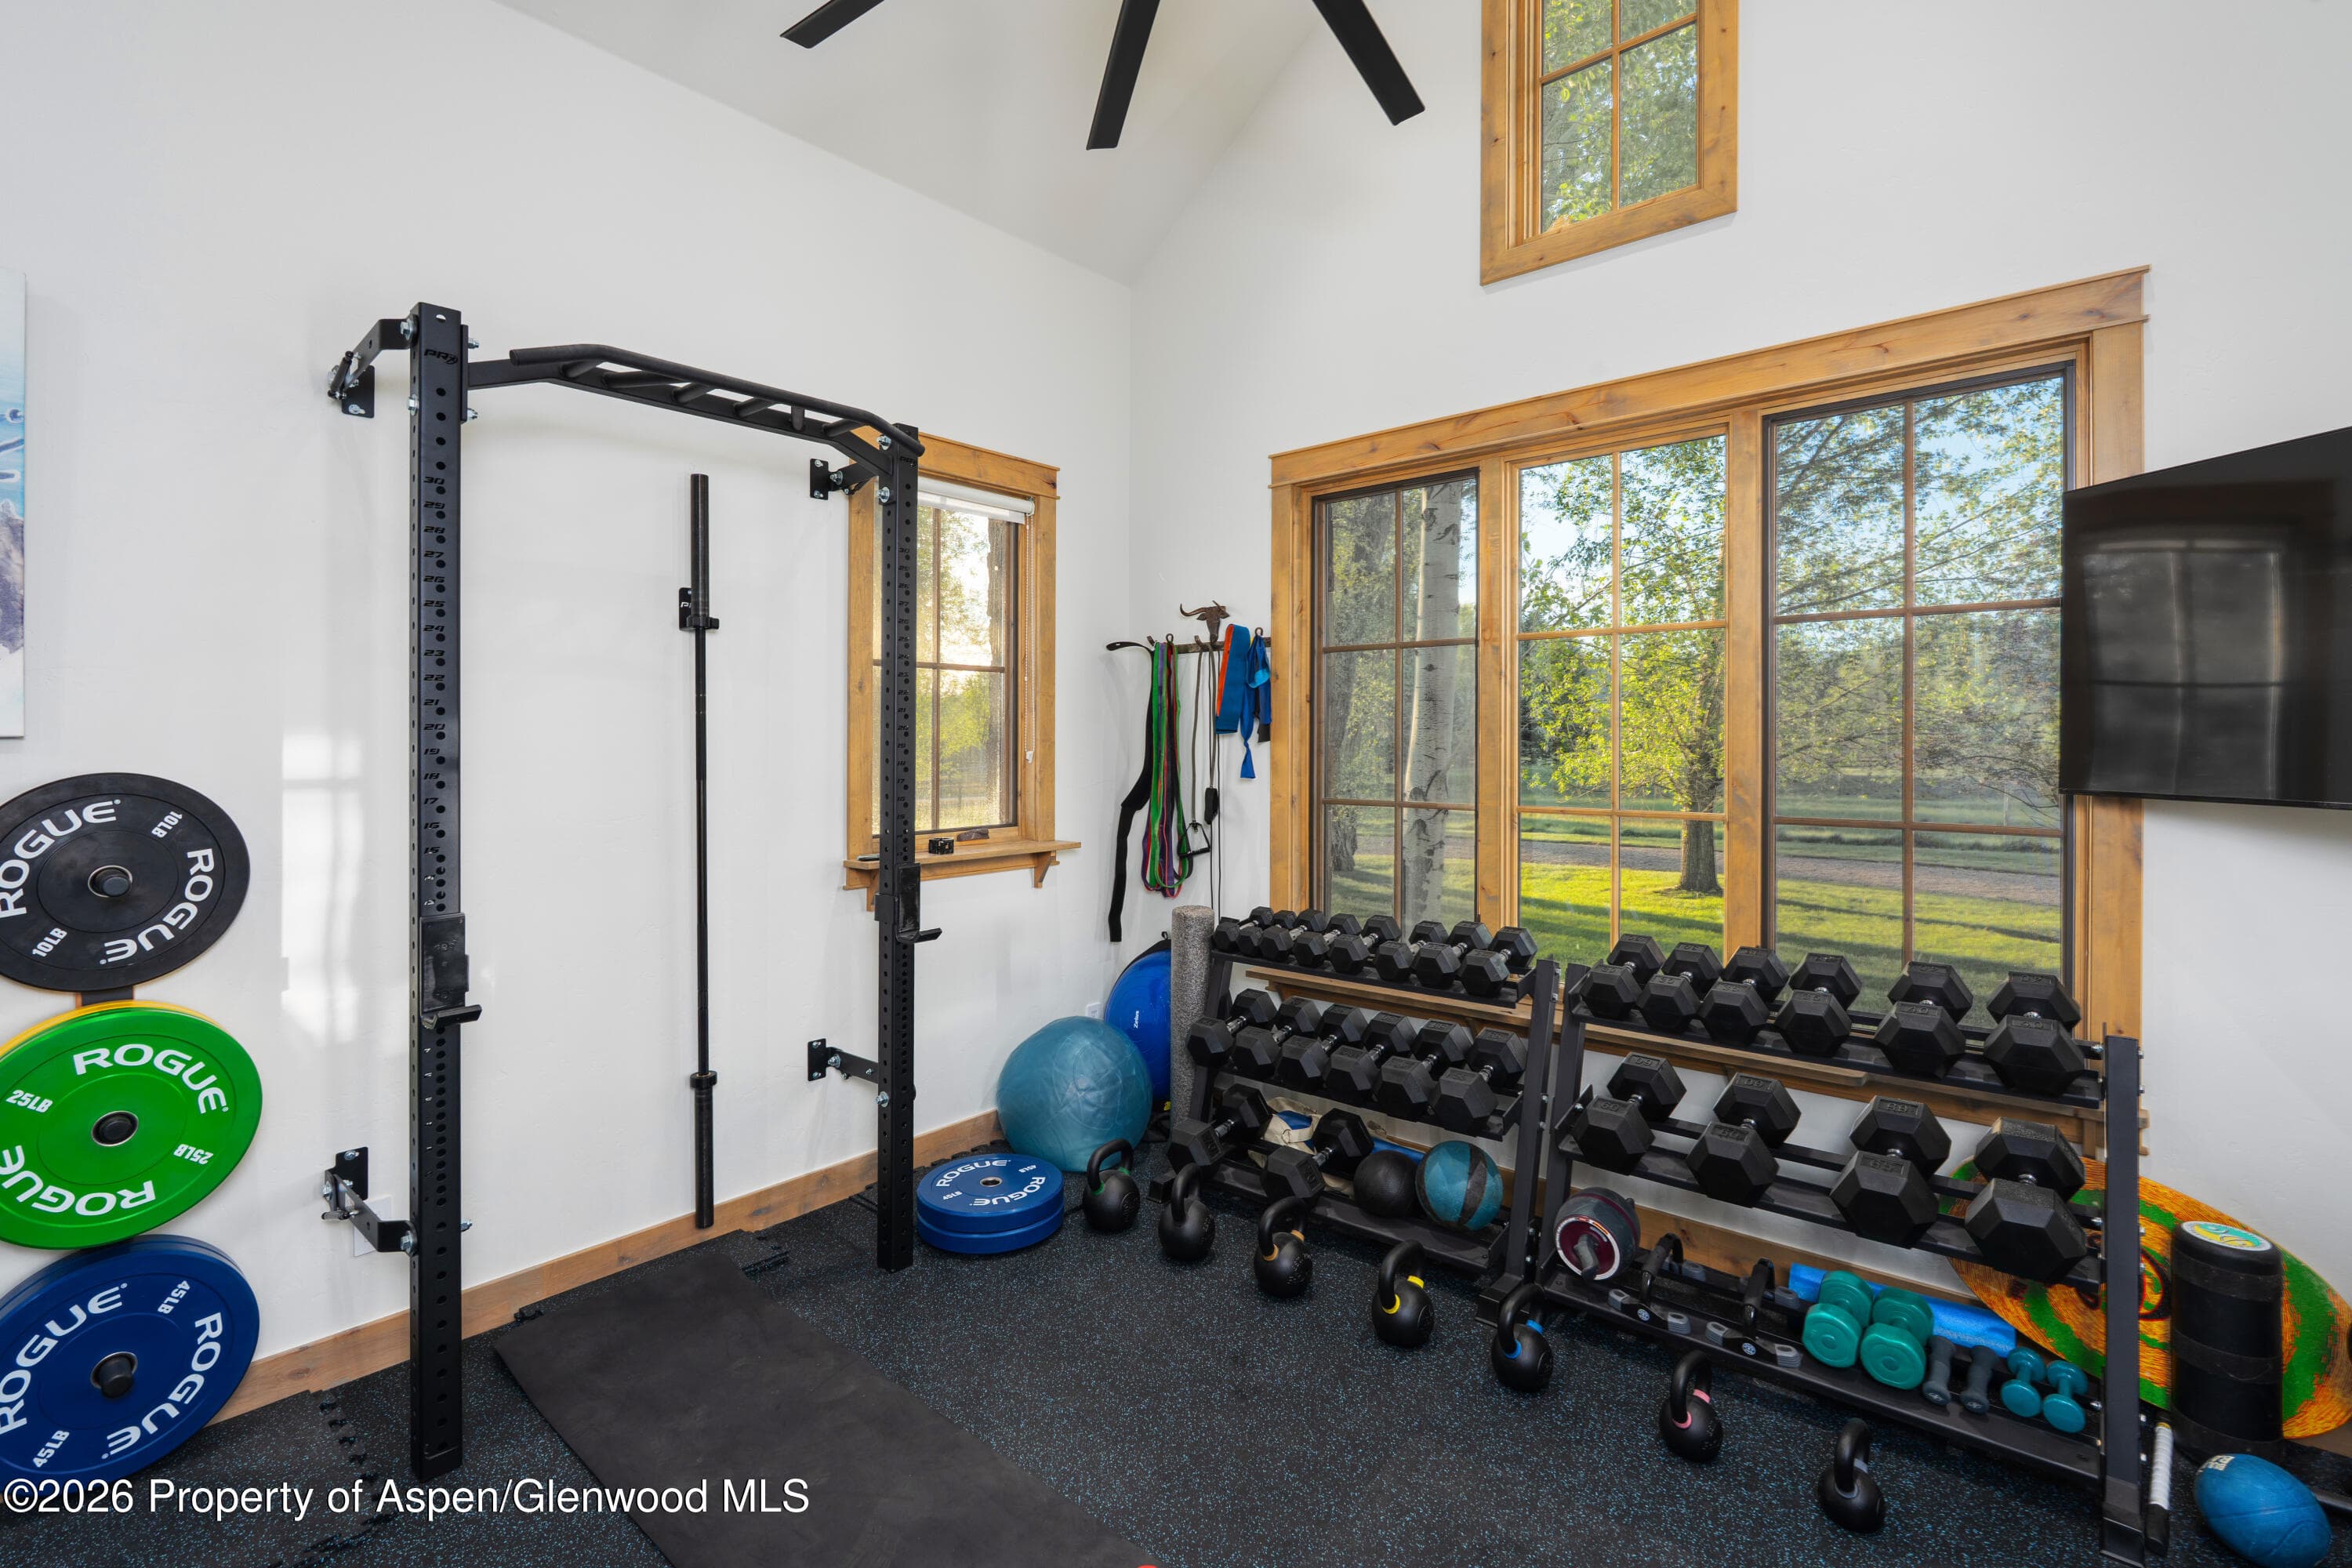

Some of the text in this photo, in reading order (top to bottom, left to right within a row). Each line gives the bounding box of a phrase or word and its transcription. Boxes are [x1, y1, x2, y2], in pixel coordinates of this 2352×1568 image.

[151, 811, 183, 838] 10LB
[0, 800, 117, 918] ROGUE
[103, 848, 215, 963] ROGUE
[32, 927, 67, 957] 10LB
[1906, 1006, 1929, 1014] 40
[73, 1044, 227, 1114] ROGUE
[6, 1090, 53, 1113] 25LB
[1599, 1102, 1619, 1112] 60
[173, 1144, 213, 1165] 25LB
[935, 1160, 1008, 1188] ROGUE
[942, 1191, 963, 1200] 45LB
[973, 1176, 1046, 1206] ROGUE
[158, 1280, 191, 1314] 45LB
[0, 1286, 122, 1435] ROGUE
[107, 1312, 223, 1455] ROGUE
[32, 1430, 70, 1468] 45LB
